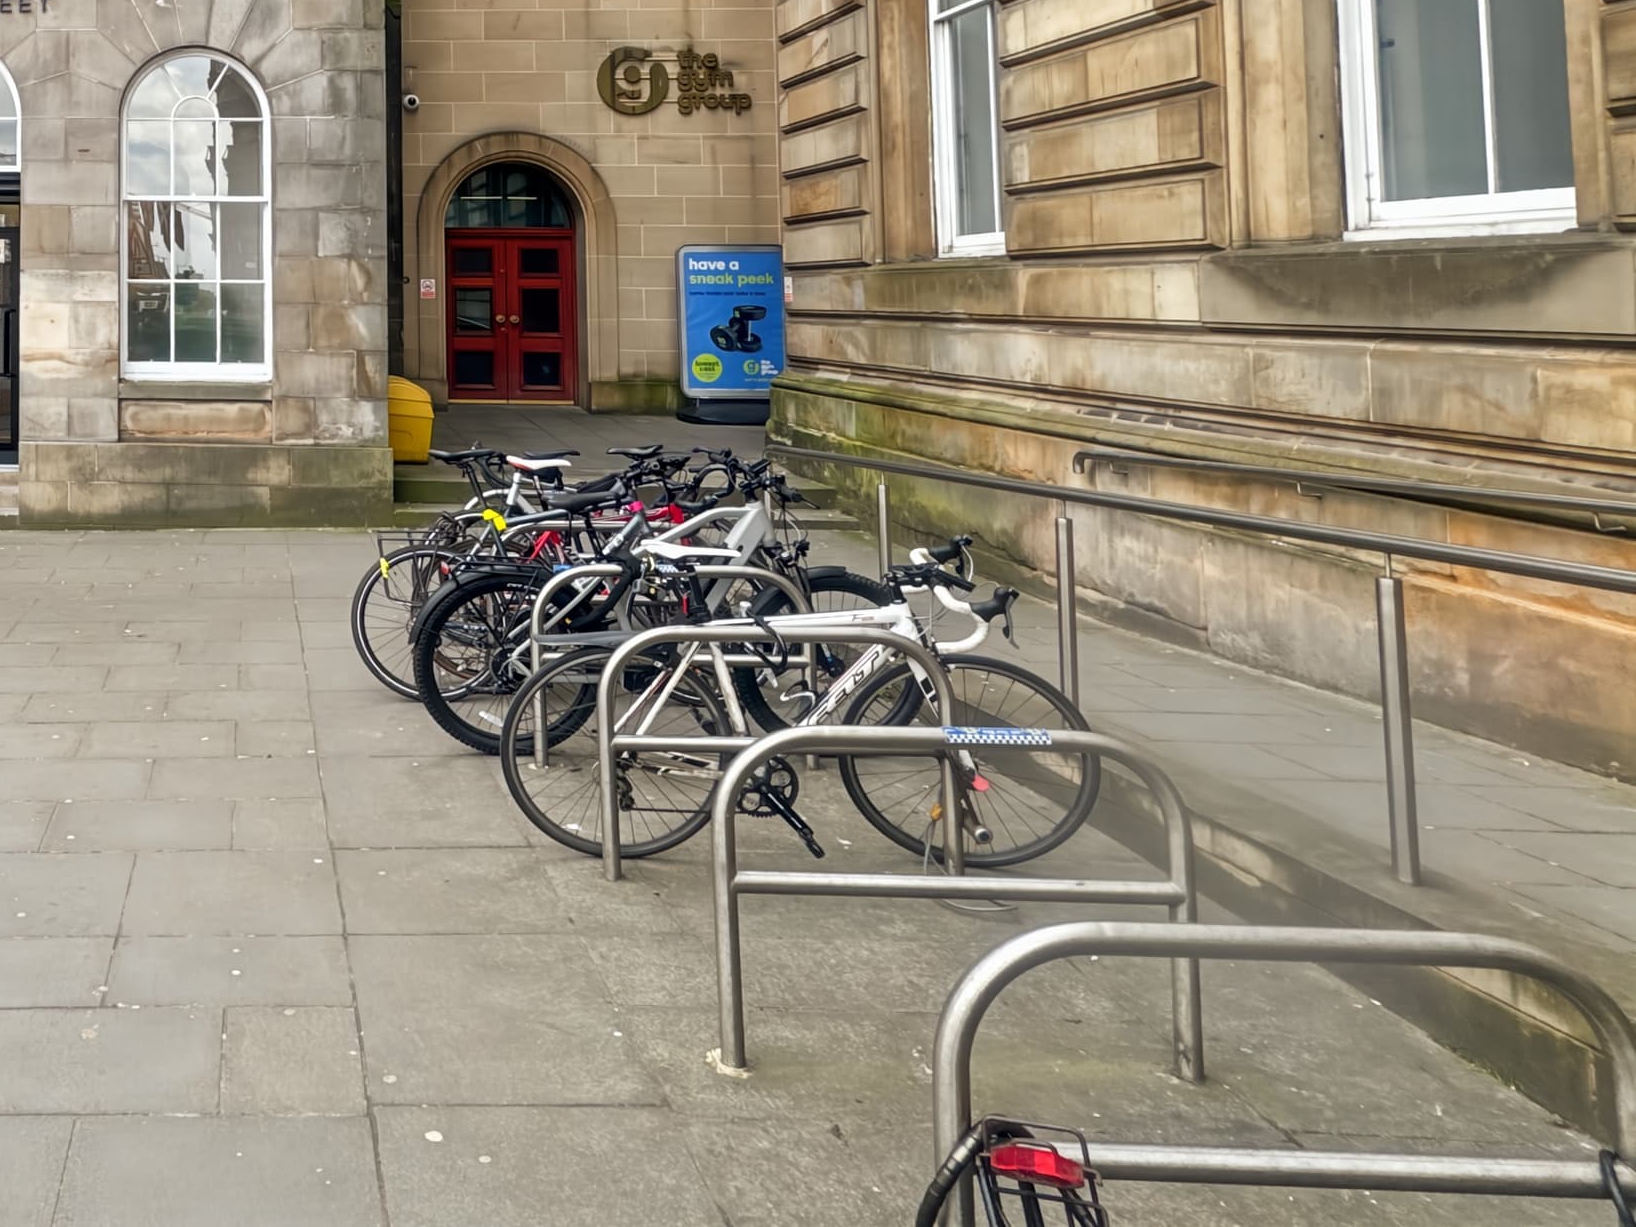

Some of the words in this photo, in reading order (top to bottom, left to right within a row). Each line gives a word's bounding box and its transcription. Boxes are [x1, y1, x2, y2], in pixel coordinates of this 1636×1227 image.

[677, 48, 718, 70] the
[677, 70, 734, 92] gym
[677, 93, 752, 115] group
[689, 258, 725, 270] have
[729, 261, 739, 270] a
[689, 275, 734, 284] sneak
[738, 274, 774, 287] peek
